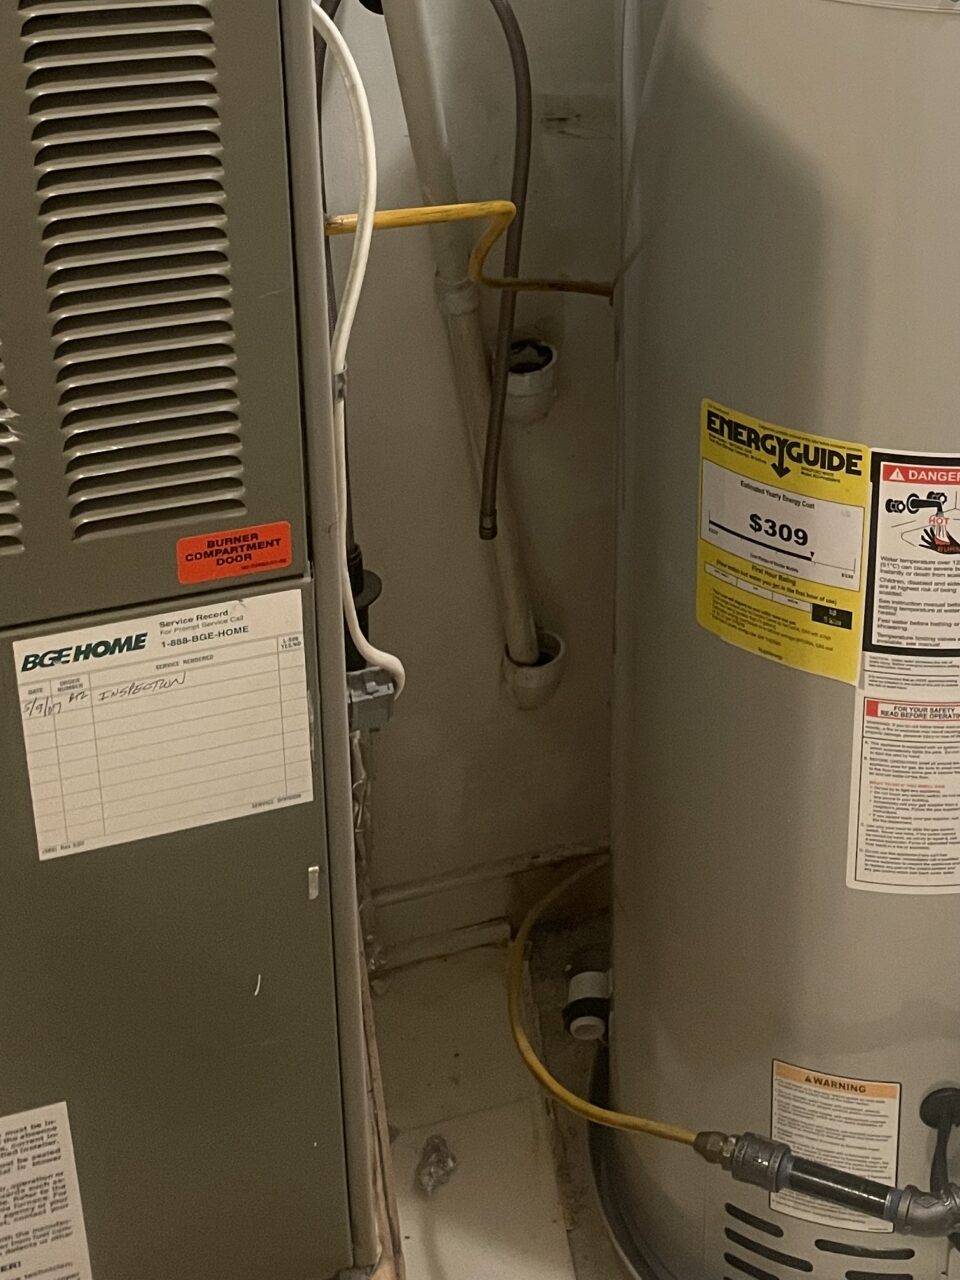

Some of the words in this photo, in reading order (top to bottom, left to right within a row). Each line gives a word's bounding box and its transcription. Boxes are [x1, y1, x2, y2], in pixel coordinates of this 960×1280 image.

[706, 410, 863, 477] ENERGYGUIDE
[783, 495, 801, 506] Energy
[802, 501, 815, 509] Cost
[749, 513, 808, 546] $309
[928, 515, 950, 526] HOT
[206, 532, 259, 549] BURNER
[184, 538, 282, 563] COMPARTMENT
[216, 553, 252, 567] DOOR
[159, 616, 194, 629] Service
[196, 608, 229, 621] Record
[160, 625, 249, 650] 1-888-BGE-HOME
[813, 1077, 867, 1093] WARNING
